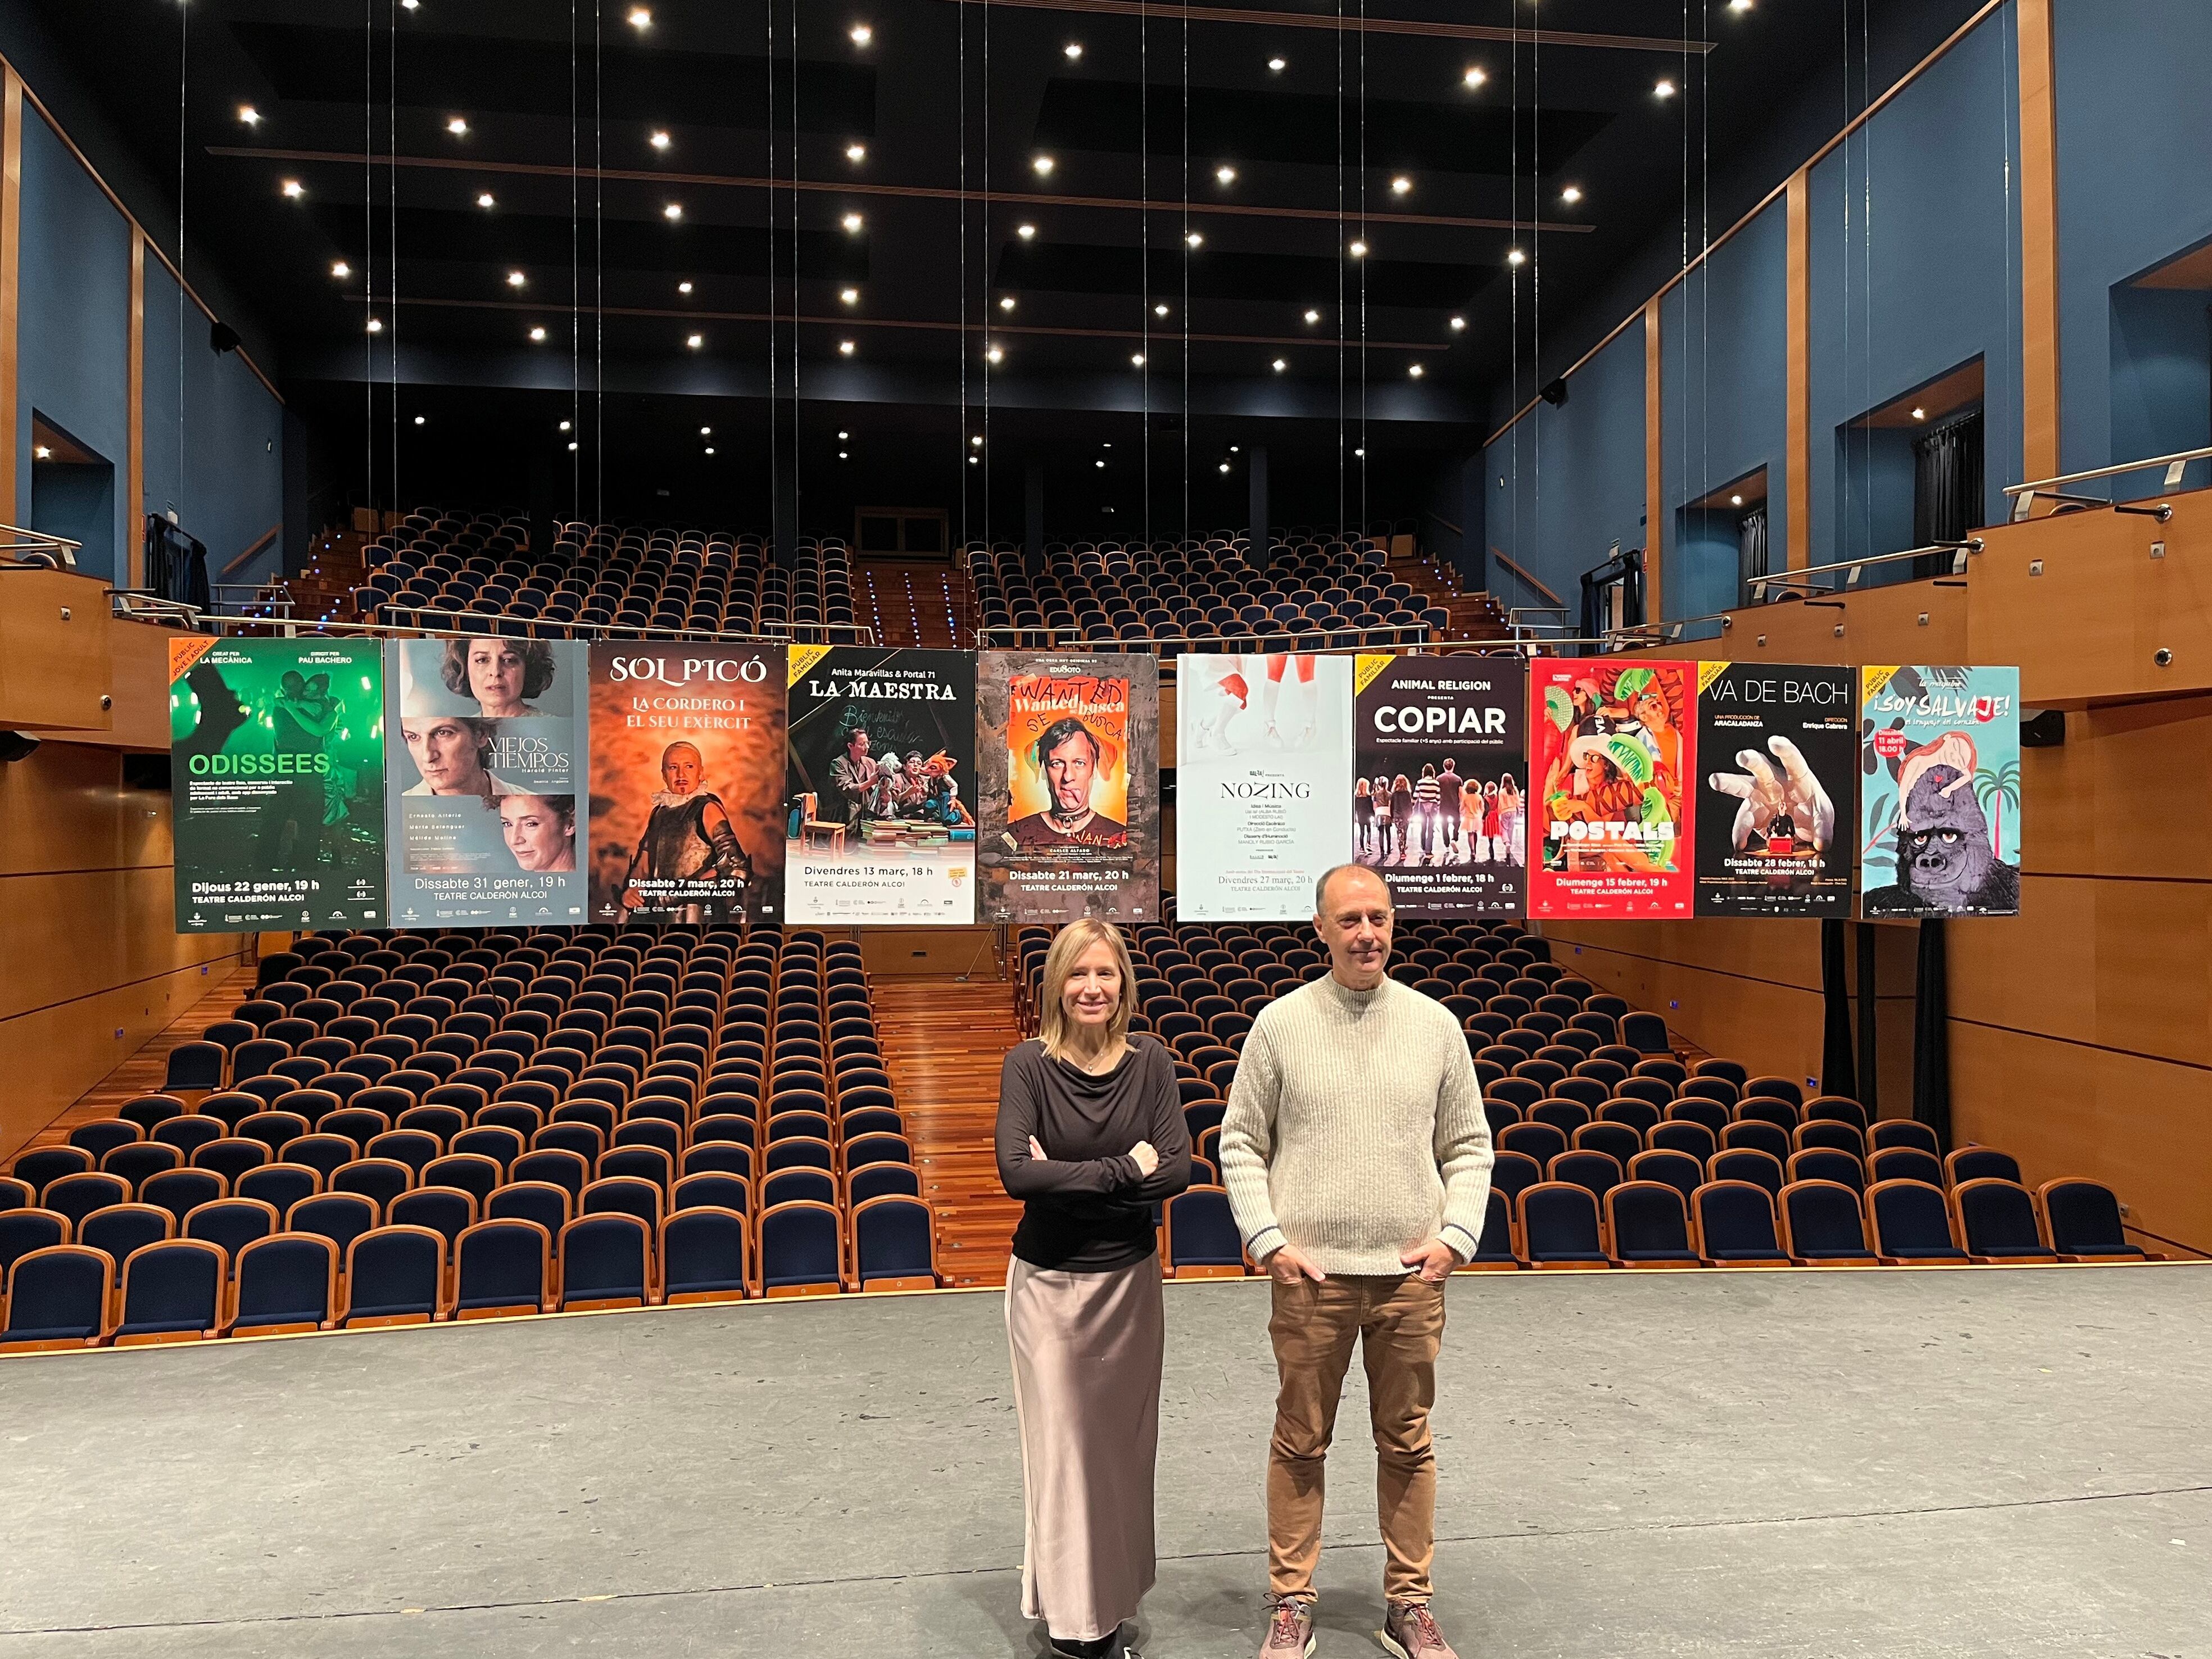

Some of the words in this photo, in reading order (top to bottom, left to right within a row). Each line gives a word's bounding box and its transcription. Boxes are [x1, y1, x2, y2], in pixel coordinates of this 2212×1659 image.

[173, 661, 188, 676] JOVE
[191, 640, 209, 659] ADULT
[793, 651, 821, 678] FAMILIAR
[610, 656, 686, 687] SOL
[682, 654, 768, 683] PICÓ
[831, 668, 852, 677] Anita
[854, 669, 893, 678] Maravillas
[1360, 660, 1385, 686] FAMILIAR
[1702, 665, 1723, 687] FAMILIAR
[809, 680, 841, 697] LA
[849, 681, 957, 700] MAESTRA
[1391, 679, 1435, 690] ANIMAL
[1438, 681, 1491, 691] RELIGION
[1708, 679, 1738, 701] VA
[1745, 680, 1776, 702] DE
[1784, 681, 1848, 704] BACH
[1867, 672, 1890, 696] FAMILIAR
[633, 697, 650, 713] LA
[653, 697, 736, 711] CORDERO
[740, 699, 744, 711] I
[1078, 701, 1125, 715] busca
[1916, 695, 2010, 718] SALVAJE!
[627, 715, 645, 728] EL
[649, 715, 679, 728] SEU
[683, 713, 751, 729] EXÈRCIT
[1374, 706, 1506, 734] COPIAR
[488, 737, 548, 753] VIEJOS
[189, 753, 330, 774] ODISSEES
[488, 753, 569, 768] TIEMPOS
[1221, 781, 1311, 799] NOZING
[1550, 821, 1675, 841] POSTALS
[1724, 858, 1763, 867] Dissabte
[1778, 859, 1806, 868] febrer,
[1819, 859, 1825, 868] h
[804, 867, 860, 875] Divendres
[878, 868, 908, 877] març,
[927, 867, 933, 876] h
[1009, 871, 1056, 880] Dissabte
[1058, 871, 1069, 880] 21
[1072, 872, 1102, 881] març,
[1104, 871, 1119, 880] 20
[1122, 871, 1129, 880] h
[1218, 876, 1258, 884] Divendres
[1385, 874, 1434, 884] Diumenge
[1435, 874, 1440, 882] 1
[1442, 874, 1474, 883] febrer,
[1475, 874, 1486, 882] 18
[1488, 874, 1494, 882] h
[192, 882, 232, 894] Dijous
[234, 881, 250, 892] 22
[253, 882, 292, 893] gener,
[294, 880, 309, 890] 19
[311, 880, 320, 890] h
[415, 877, 469, 890] Dissabte
[474, 877, 487, 889] 31
[493, 878, 533, 891] gener,
[540, 876, 554, 887] 19
[558, 876, 565, 887] h
[629, 878, 676, 888] Dissabte
[678, 879, 686, 888] 7
[687, 881, 717, 890] març,
[720, 879, 735, 888] 20
[737, 878, 744, 888] h
[1556, 878, 1603, 887] Diumenge
[1617, 878, 1647, 887] febrer,
[1662, 878, 1667, 886] h
[227, 894, 276, 903] CALDERÓN
[434, 892, 468, 901] TEATRE
[469, 890, 518, 900] CALDERÓN
[520, 891, 547, 899] ALCOI
